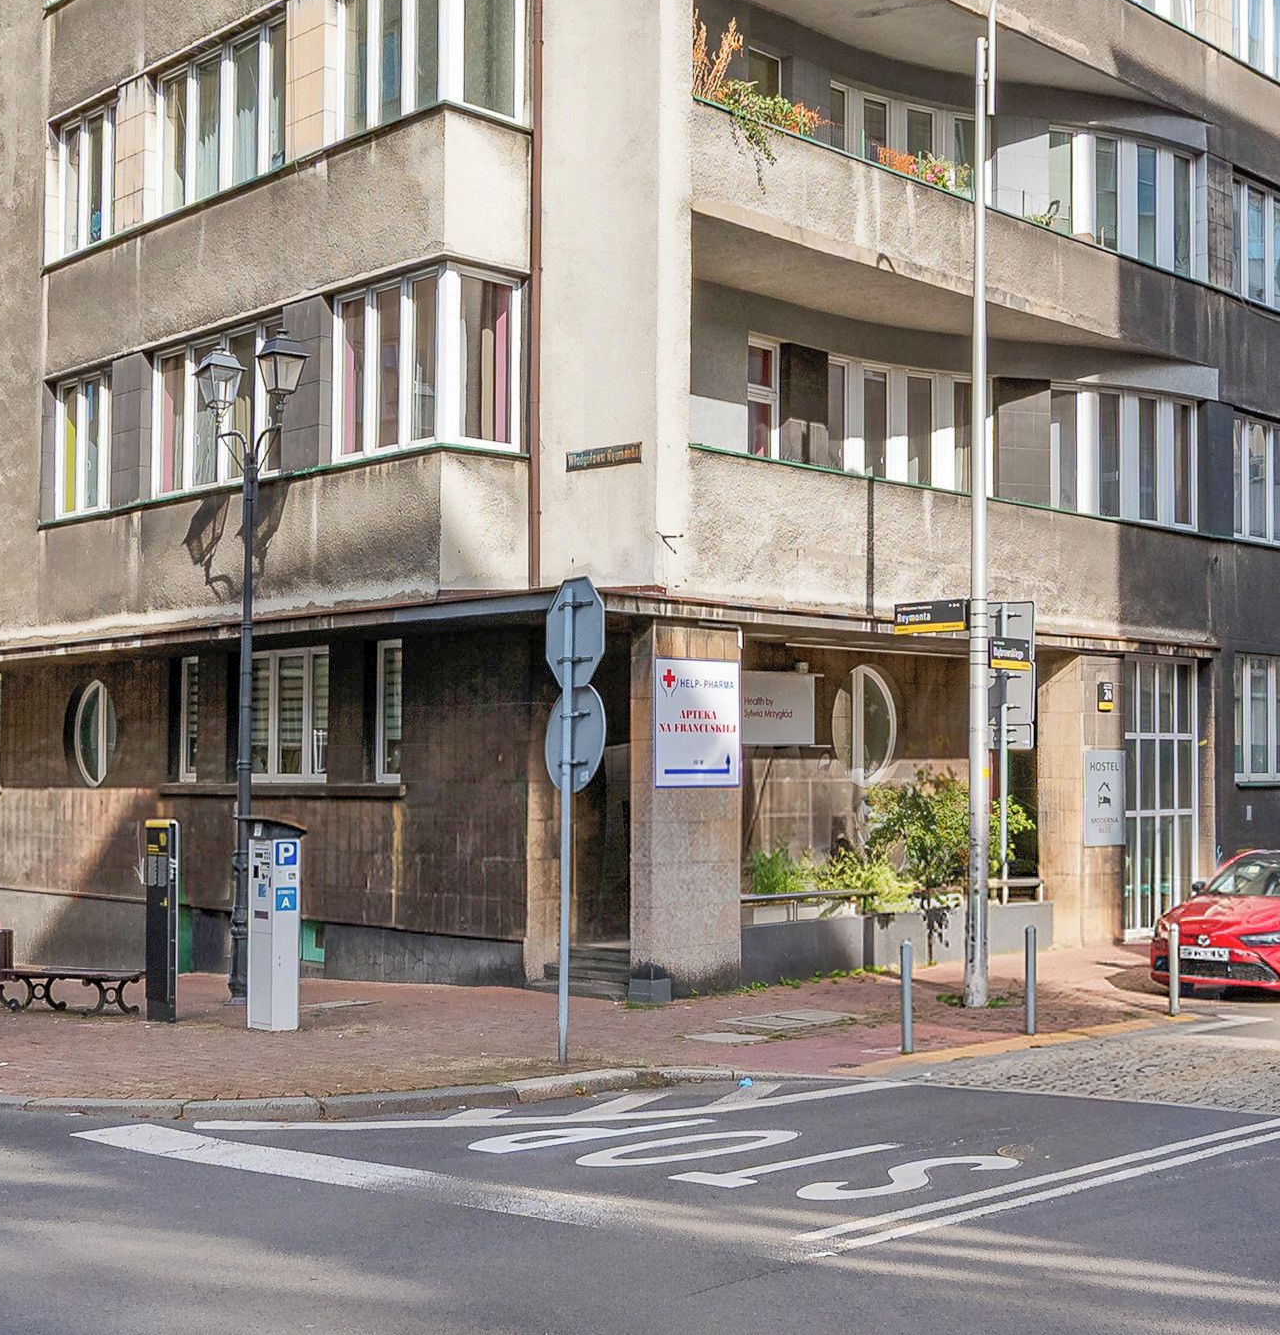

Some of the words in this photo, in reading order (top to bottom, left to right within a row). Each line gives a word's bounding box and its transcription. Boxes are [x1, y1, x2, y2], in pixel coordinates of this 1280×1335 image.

[896, 612, 931, 625] Reymonta
[744, 697, 766, 706] Health
[766, 697, 774, 707] by
[679, 710, 717, 720] APTEKA
[744, 709, 763, 719] Sylwia
[659, 723, 671, 733] NA
[674, 723, 736, 733] FRANCUSKIEJ
[1089, 761, 1120, 772] HOSTEL
[278, 843, 295, 865] P
[281, 896, 291, 909] A
[467, 1118, 1023, 1201] STOP
